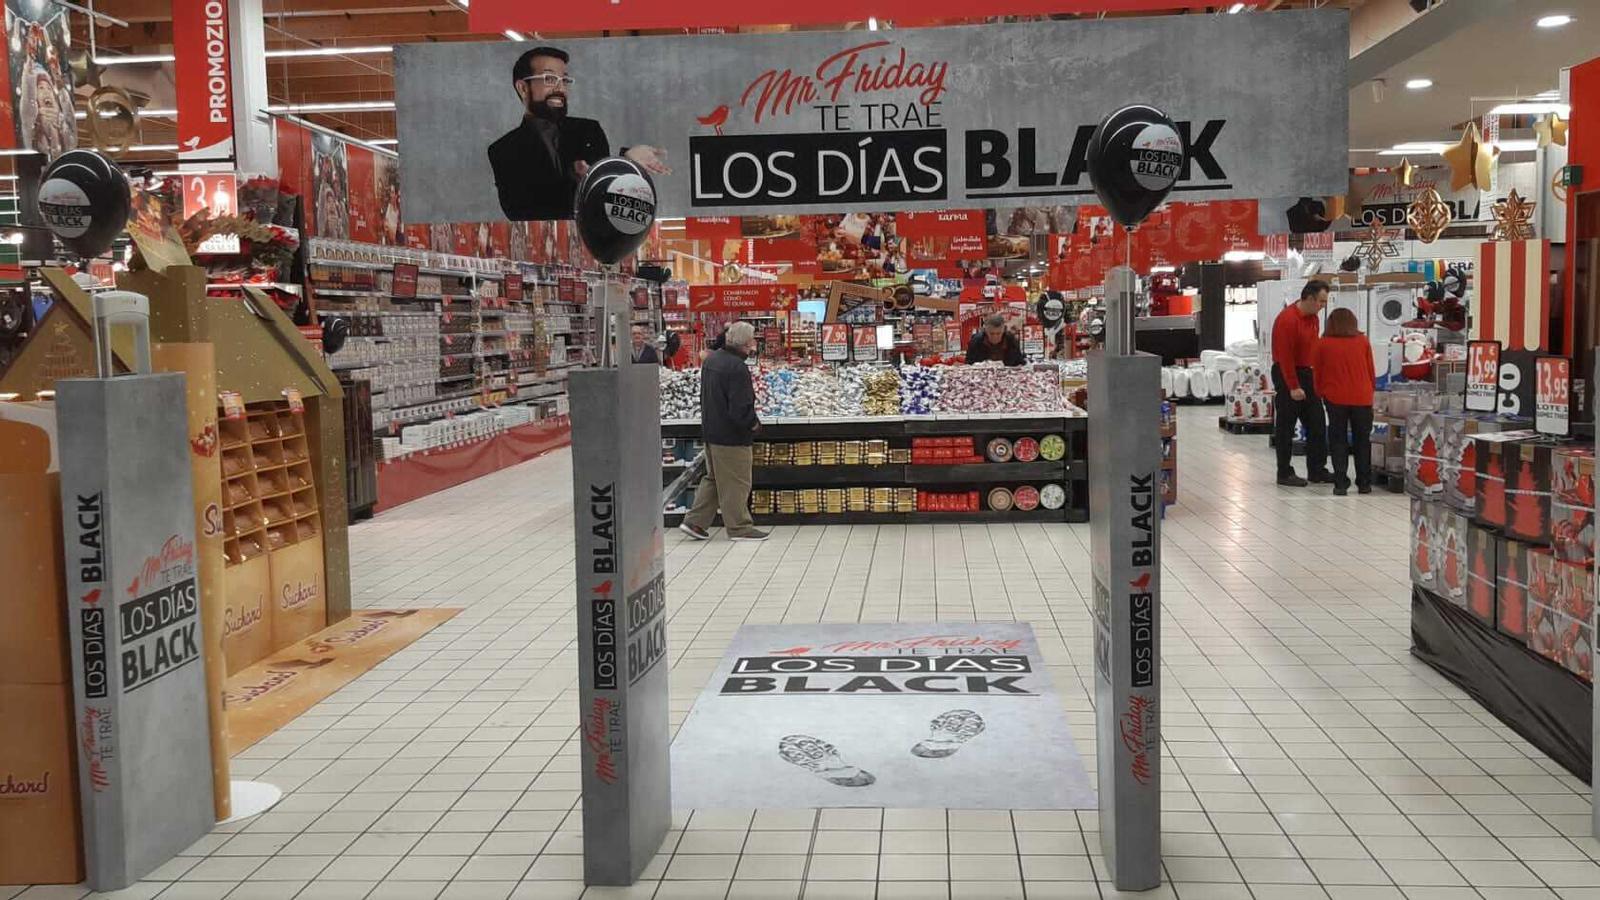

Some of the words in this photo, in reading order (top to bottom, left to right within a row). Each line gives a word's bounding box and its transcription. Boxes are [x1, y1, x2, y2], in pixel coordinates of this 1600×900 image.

[740, 69, 820, 124] Mr.
[816, 40, 948, 107] Friday
[814, 105, 850, 131] TE
[860, 101, 942, 129] TRAE
[694, 151, 797, 199] LOS
[818, 136, 943, 195] DÍAS
[1137, 161, 1176, 178] BLACK
[610, 205, 648, 225] BLACK
[78, 494, 103, 583] BLACK
[591, 484, 614, 573] BLACK
[1130, 473, 1152, 567] BLACK
[282, 574, 320, 609] Suchard
[83, 610, 104, 655] DÍAS
[121, 600, 155, 640] LOS
[160, 585, 196, 624] DÍAS
[224, 594, 263, 636] Suchard
[594, 602, 614, 643] DÍAS
[628, 594, 647, 632] LOS
[1132, 597, 1150, 642] DÍAS
[121, 622, 198, 688] BLACK
[597, 652, 616, 687] LOS
[628, 616, 666, 682] BLACK
[737, 657, 856, 673] LOS
[880, 655, 1026, 673] DÍAS
[1135, 649, 1153, 686] LOS
[87, 660, 106, 697] LOS
[720, 675, 1034, 694] BLACK
